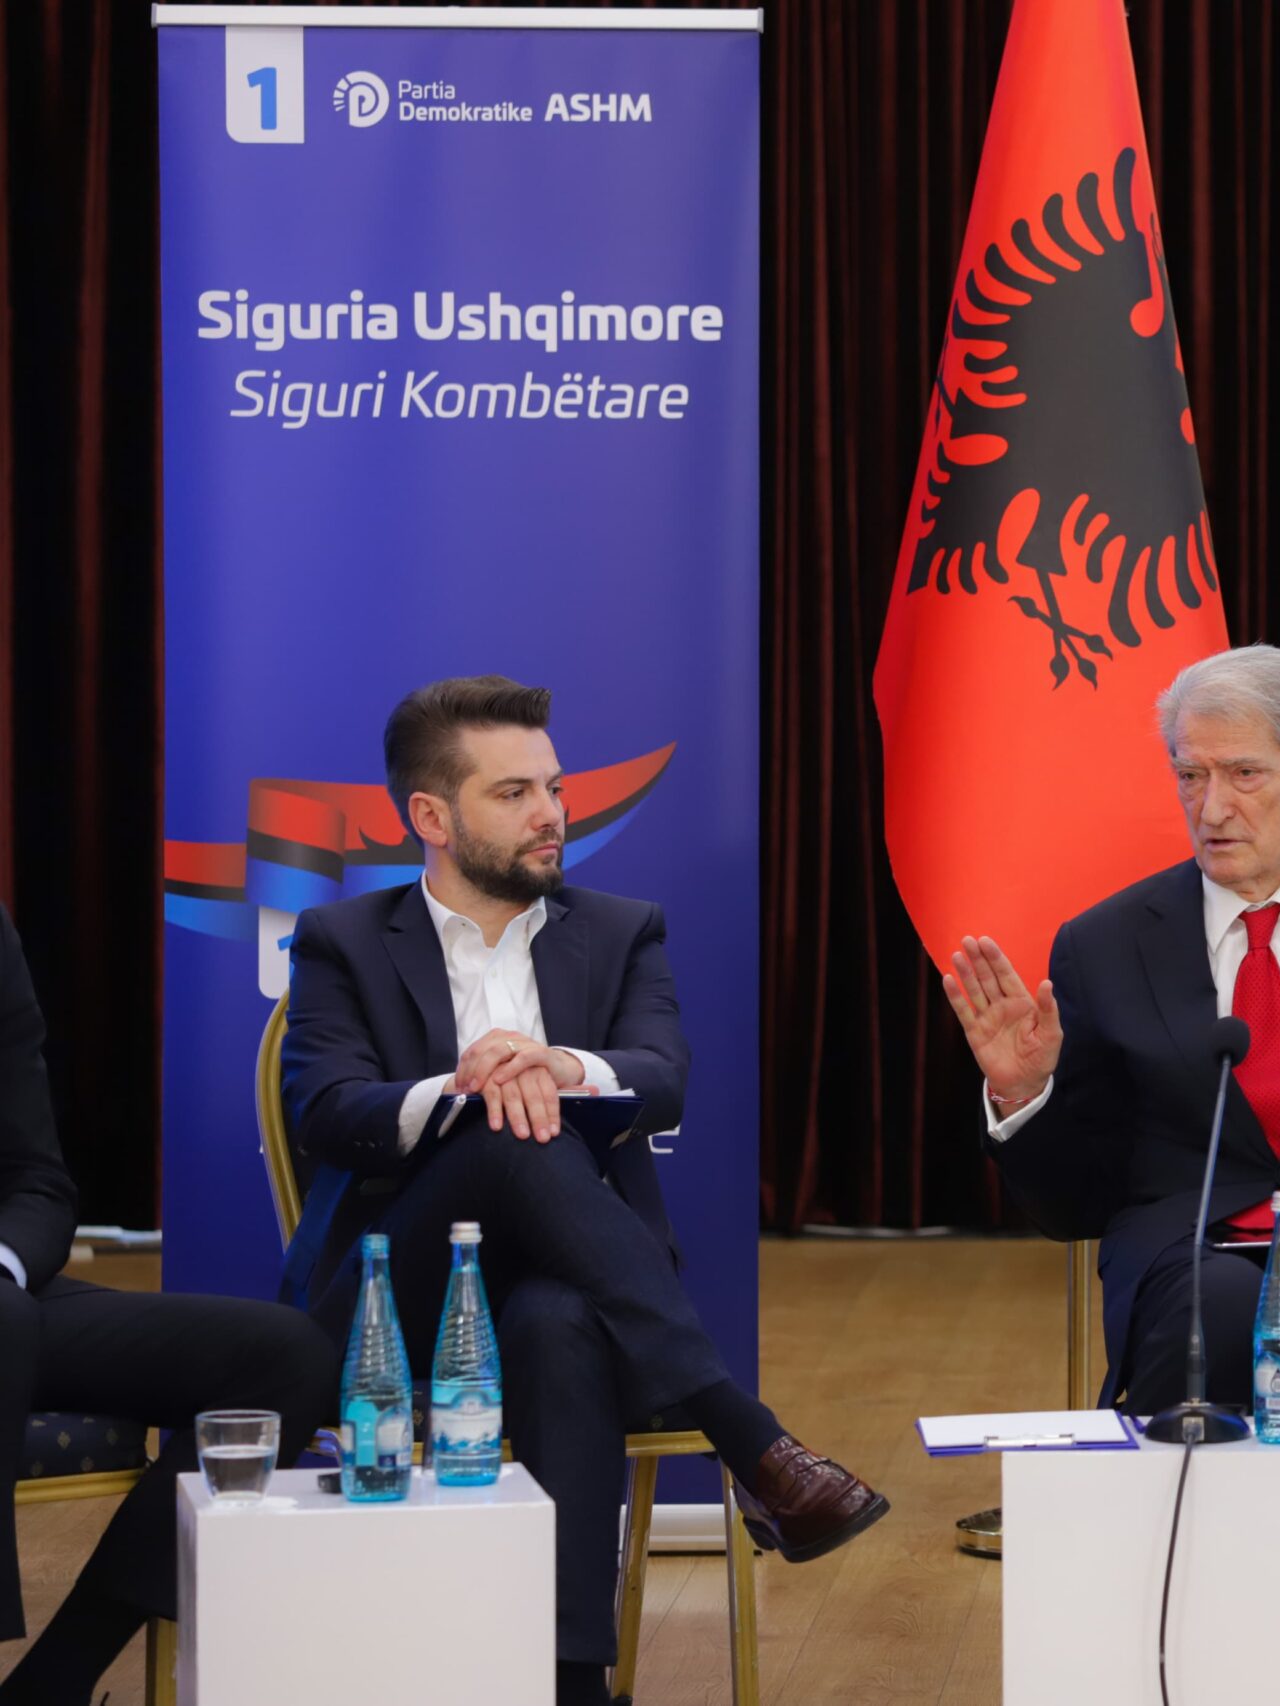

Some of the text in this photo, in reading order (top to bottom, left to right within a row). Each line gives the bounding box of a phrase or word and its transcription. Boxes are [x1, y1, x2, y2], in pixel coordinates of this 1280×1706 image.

[246, 66, 278, 131] 1
[398, 79, 456, 100] Partia
[398, 101, 533, 122] Demokratike
[544, 92, 653, 123] ASHM
[198, 288, 724, 353] Siguria Ushqimore
[229, 369, 689, 430] Siguri Kombëtare
